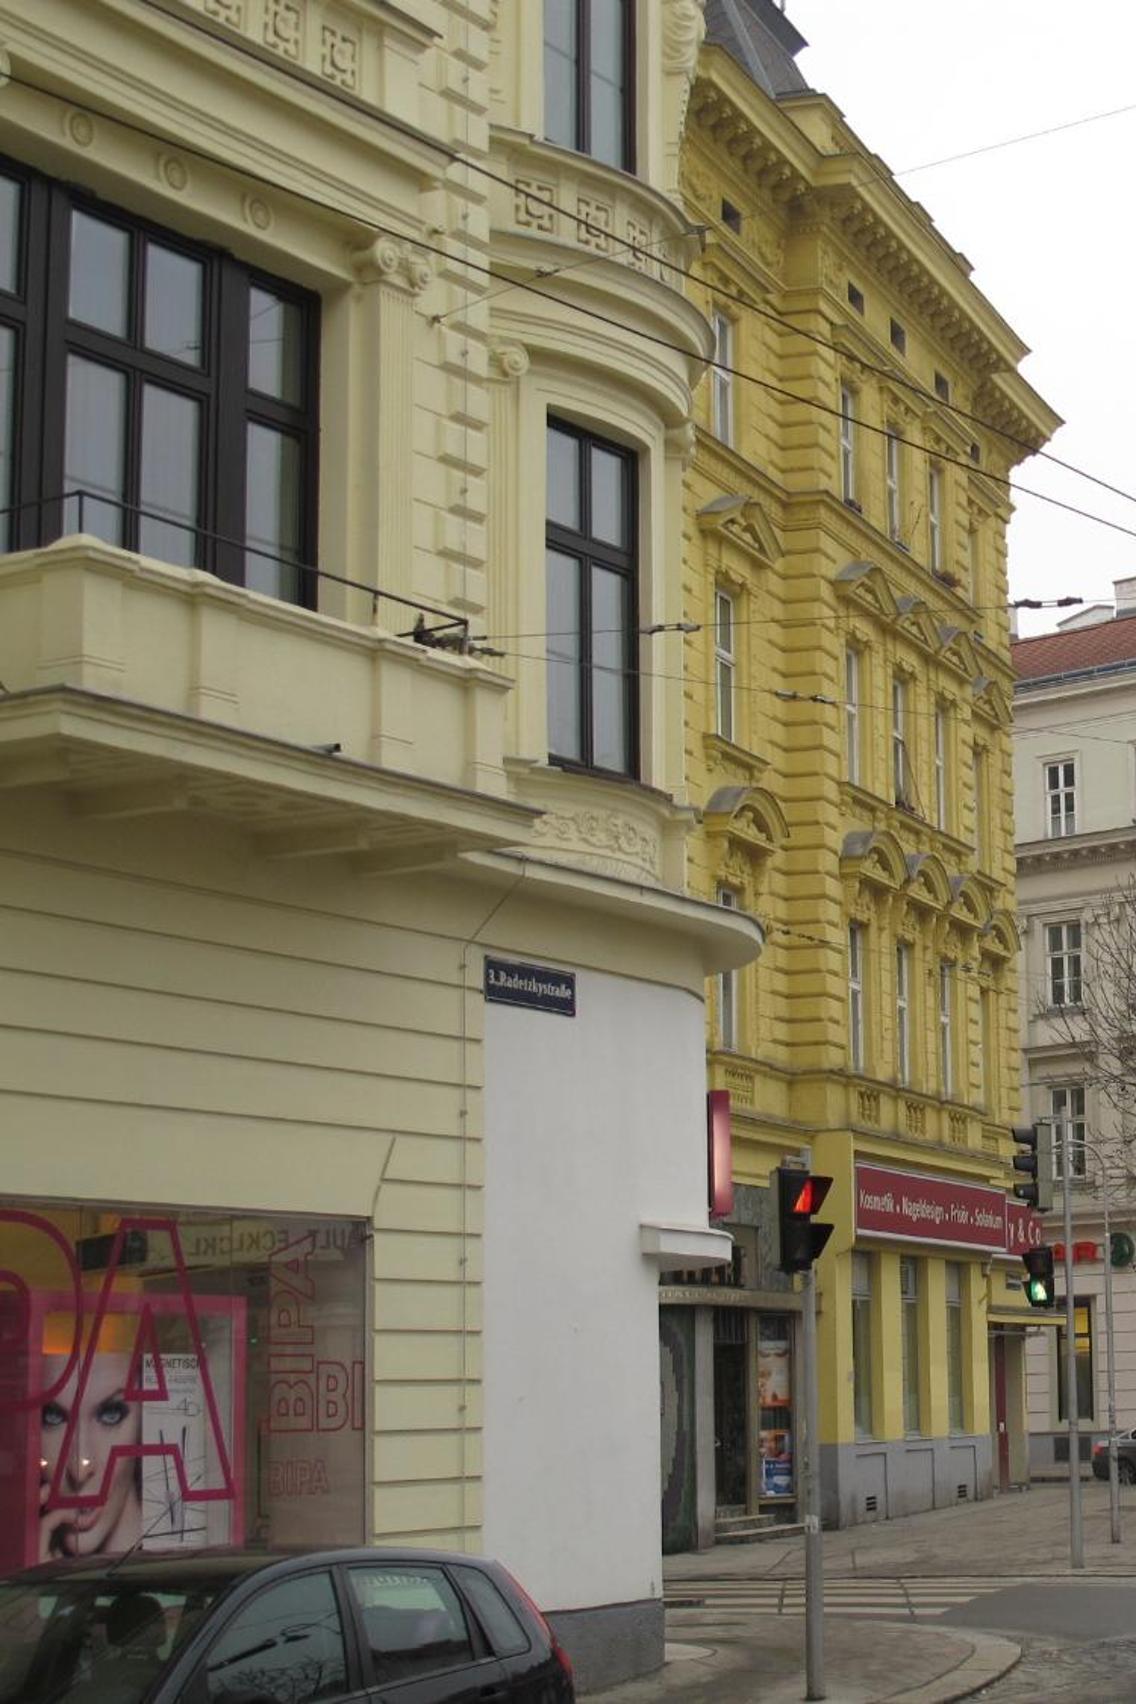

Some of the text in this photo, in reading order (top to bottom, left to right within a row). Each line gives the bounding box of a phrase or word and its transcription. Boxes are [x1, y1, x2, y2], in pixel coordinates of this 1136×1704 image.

[859, 1189, 1003, 1229] Kosmetik Nageldesign Frisör Solarium
[266, 1457, 332, 1496] BIPA
